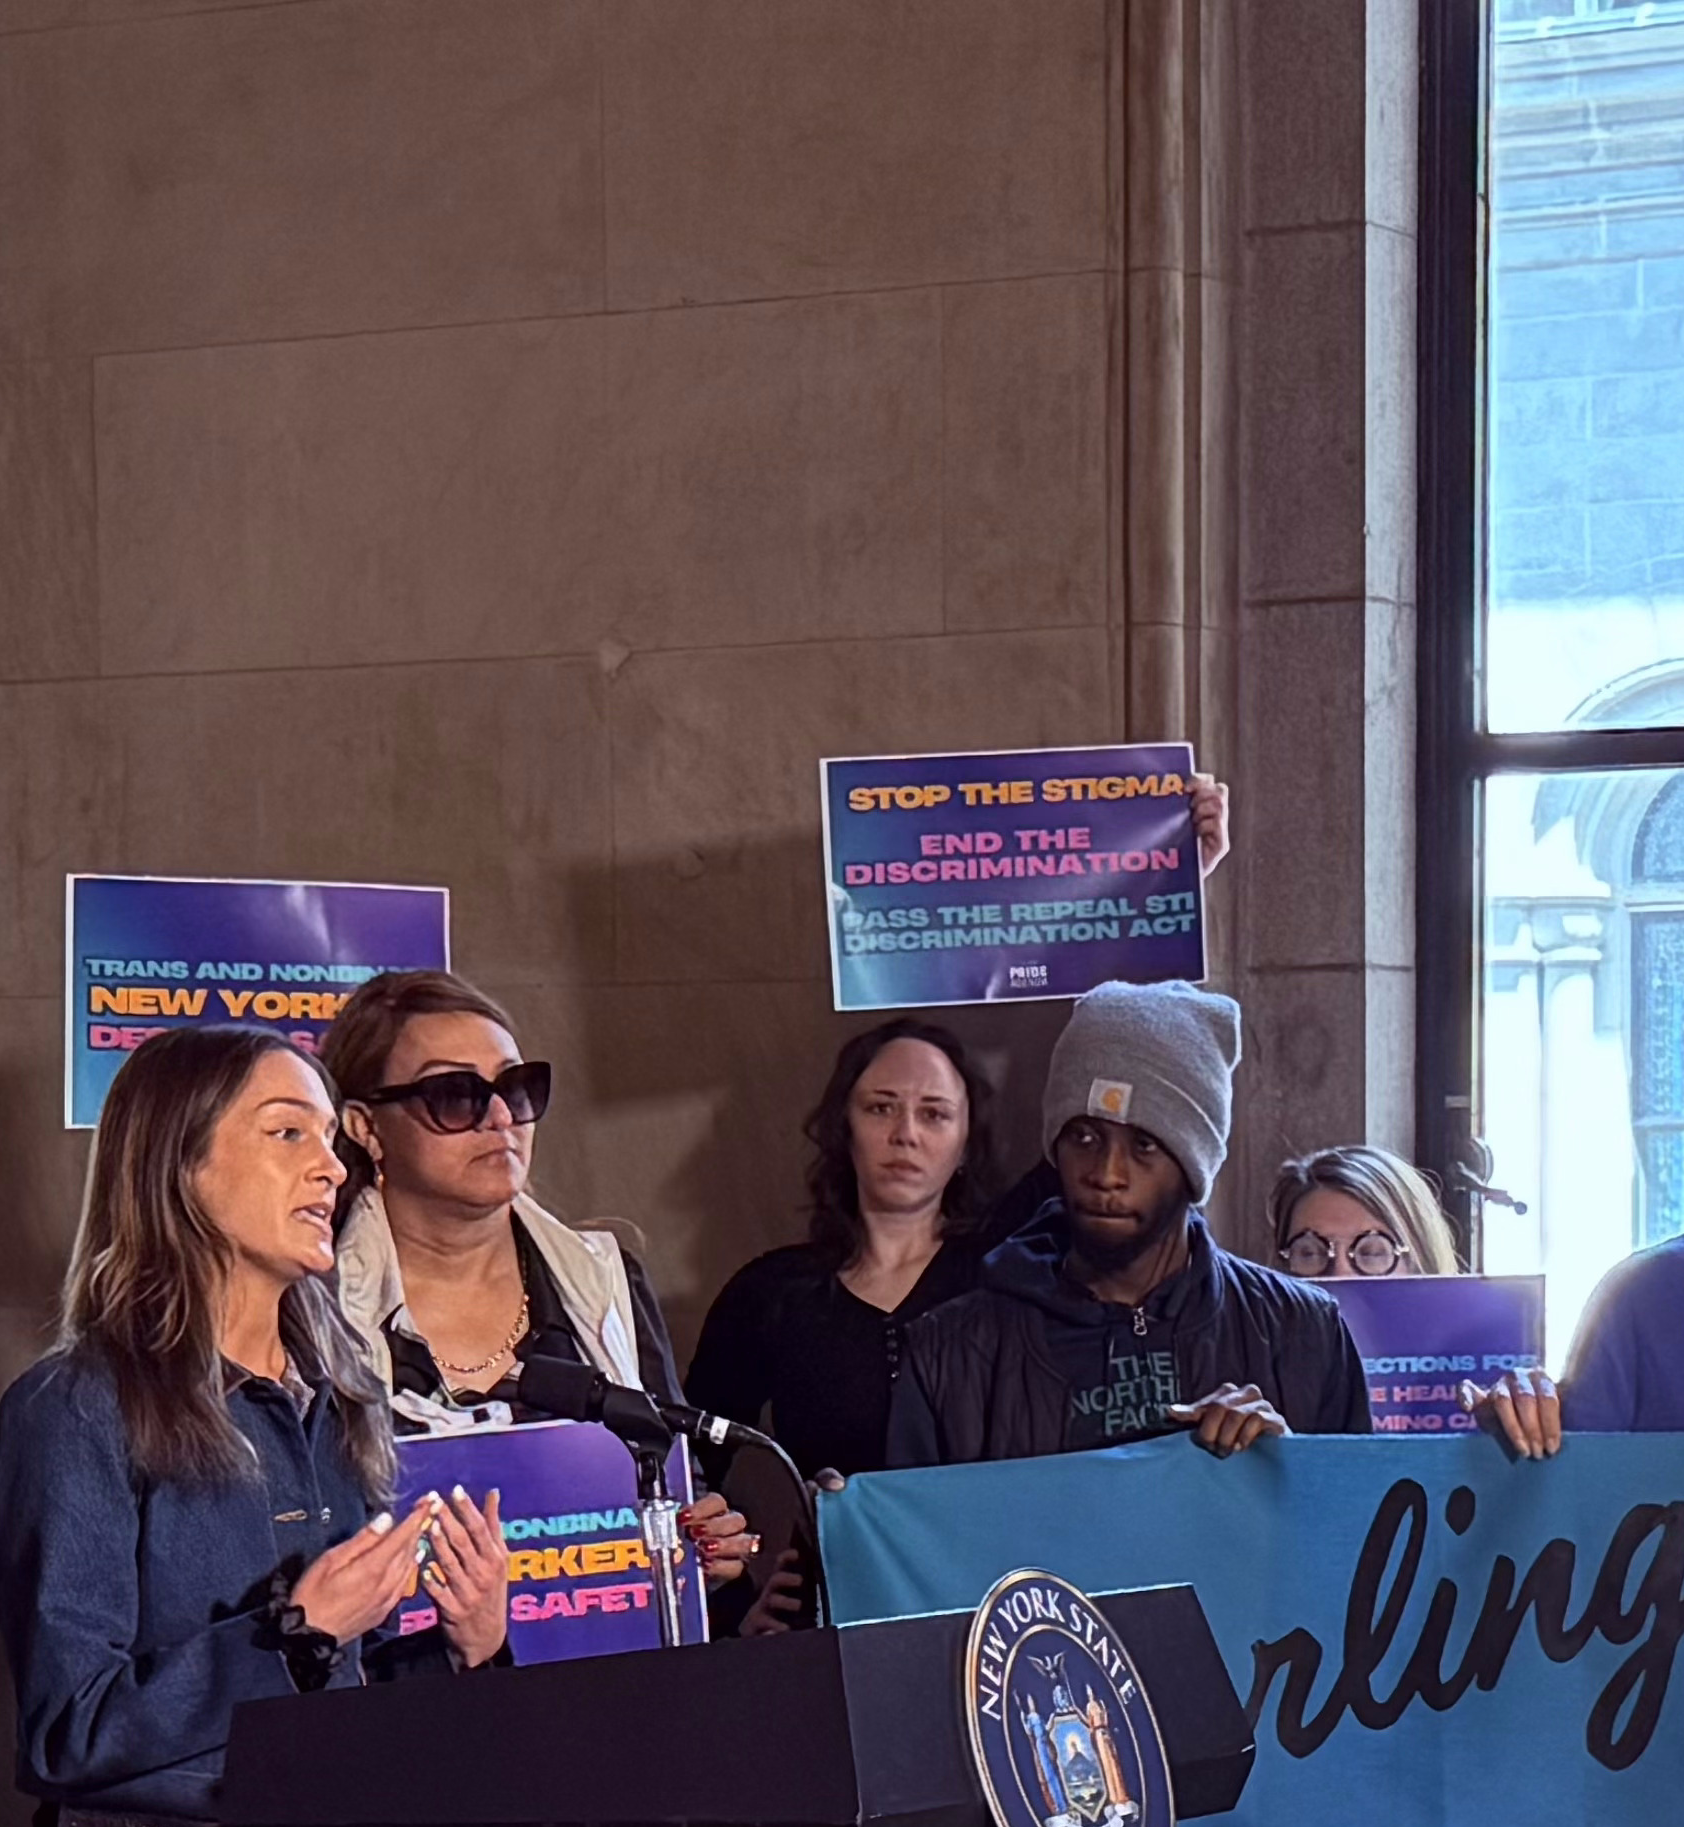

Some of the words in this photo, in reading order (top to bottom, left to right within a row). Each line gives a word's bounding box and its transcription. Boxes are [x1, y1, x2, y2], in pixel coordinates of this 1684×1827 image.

[848, 784, 951, 813] STOP
[958, 780, 1035, 807] THE
[1041, 773, 1184, 802] STIGMA
[919, 831, 1004, 858] END
[1014, 827, 1092, 852] THE
[844, 848, 1180, 886] DISCRIMINATION
[842, 909, 929, 932] PASS
[936, 903, 1002, 927] THE
[1010, 897, 1138, 924] REPEAL
[1144, 891, 1195, 914] STI
[843, 920, 1120, 954] DISCRIMINATION
[1127, 914, 1198, 938] ACT
[86, 958, 189, 980] TRANS
[196, 962, 264, 982] AND
[269, 963, 387, 984] NONBIN
[90, 985, 209, 1017] NEW
[218, 988, 353, 1020] YORK
[1110, 1351, 1174, 1381] THE
[1363, 1354, 1477, 1375] ECTIONS
[1071, 1375, 1181, 1418] NORTH
[509, 1574, 686, 1622] SAFET
[979, 1622, 1012, 1722] NEW
[1001, 1585, 1067, 1634] YORK
[1067, 1602, 1138, 1707] STATE
